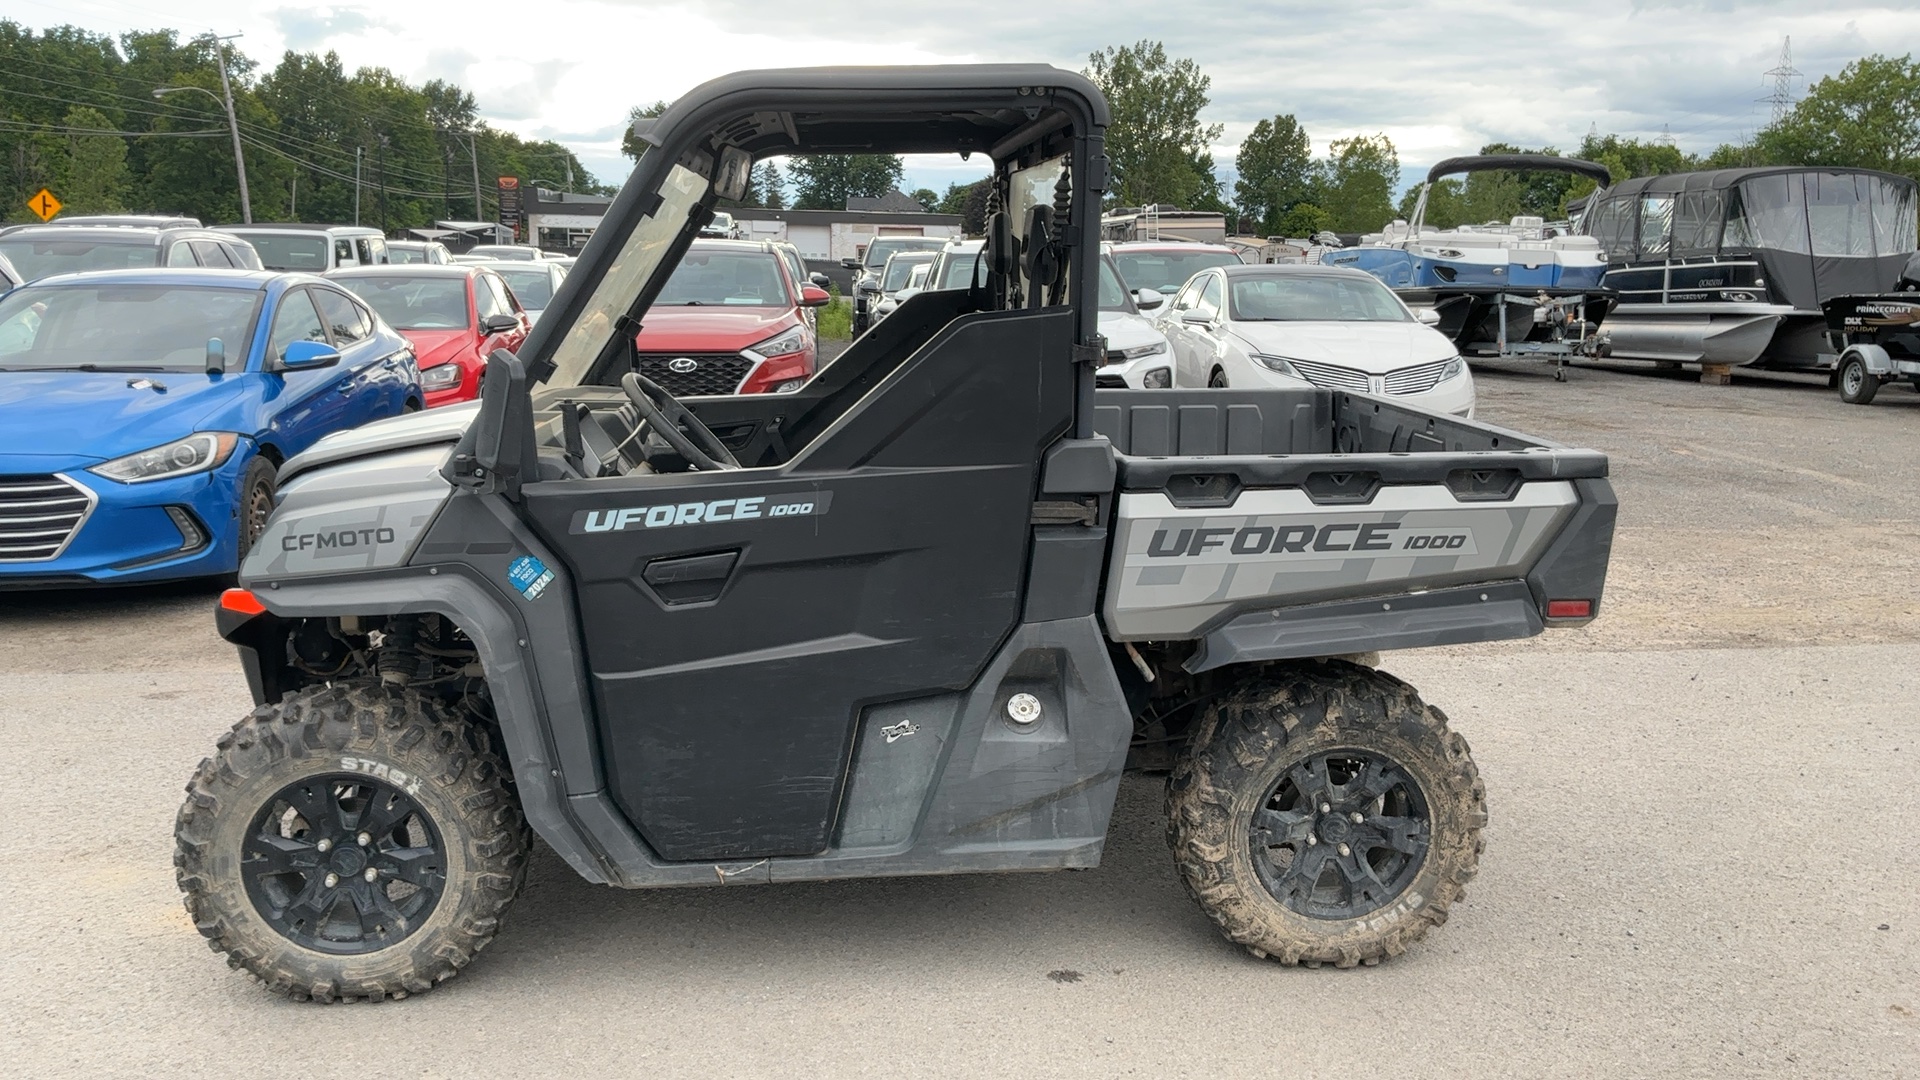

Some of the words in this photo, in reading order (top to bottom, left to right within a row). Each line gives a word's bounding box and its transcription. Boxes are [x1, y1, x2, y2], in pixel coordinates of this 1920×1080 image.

[1856, 305, 1912, 313] PRINCECRAFT
[1844, 317, 1862, 325] DLX
[585, 497, 766, 533] UFORCE
[768, 502, 814, 517] 1000
[282, 528, 395, 551] CFMOTO
[1147, 522, 1401, 558] UFORCE
[1403, 534, 1467, 550] 1000
[528, 574, 551, 597] 2024
